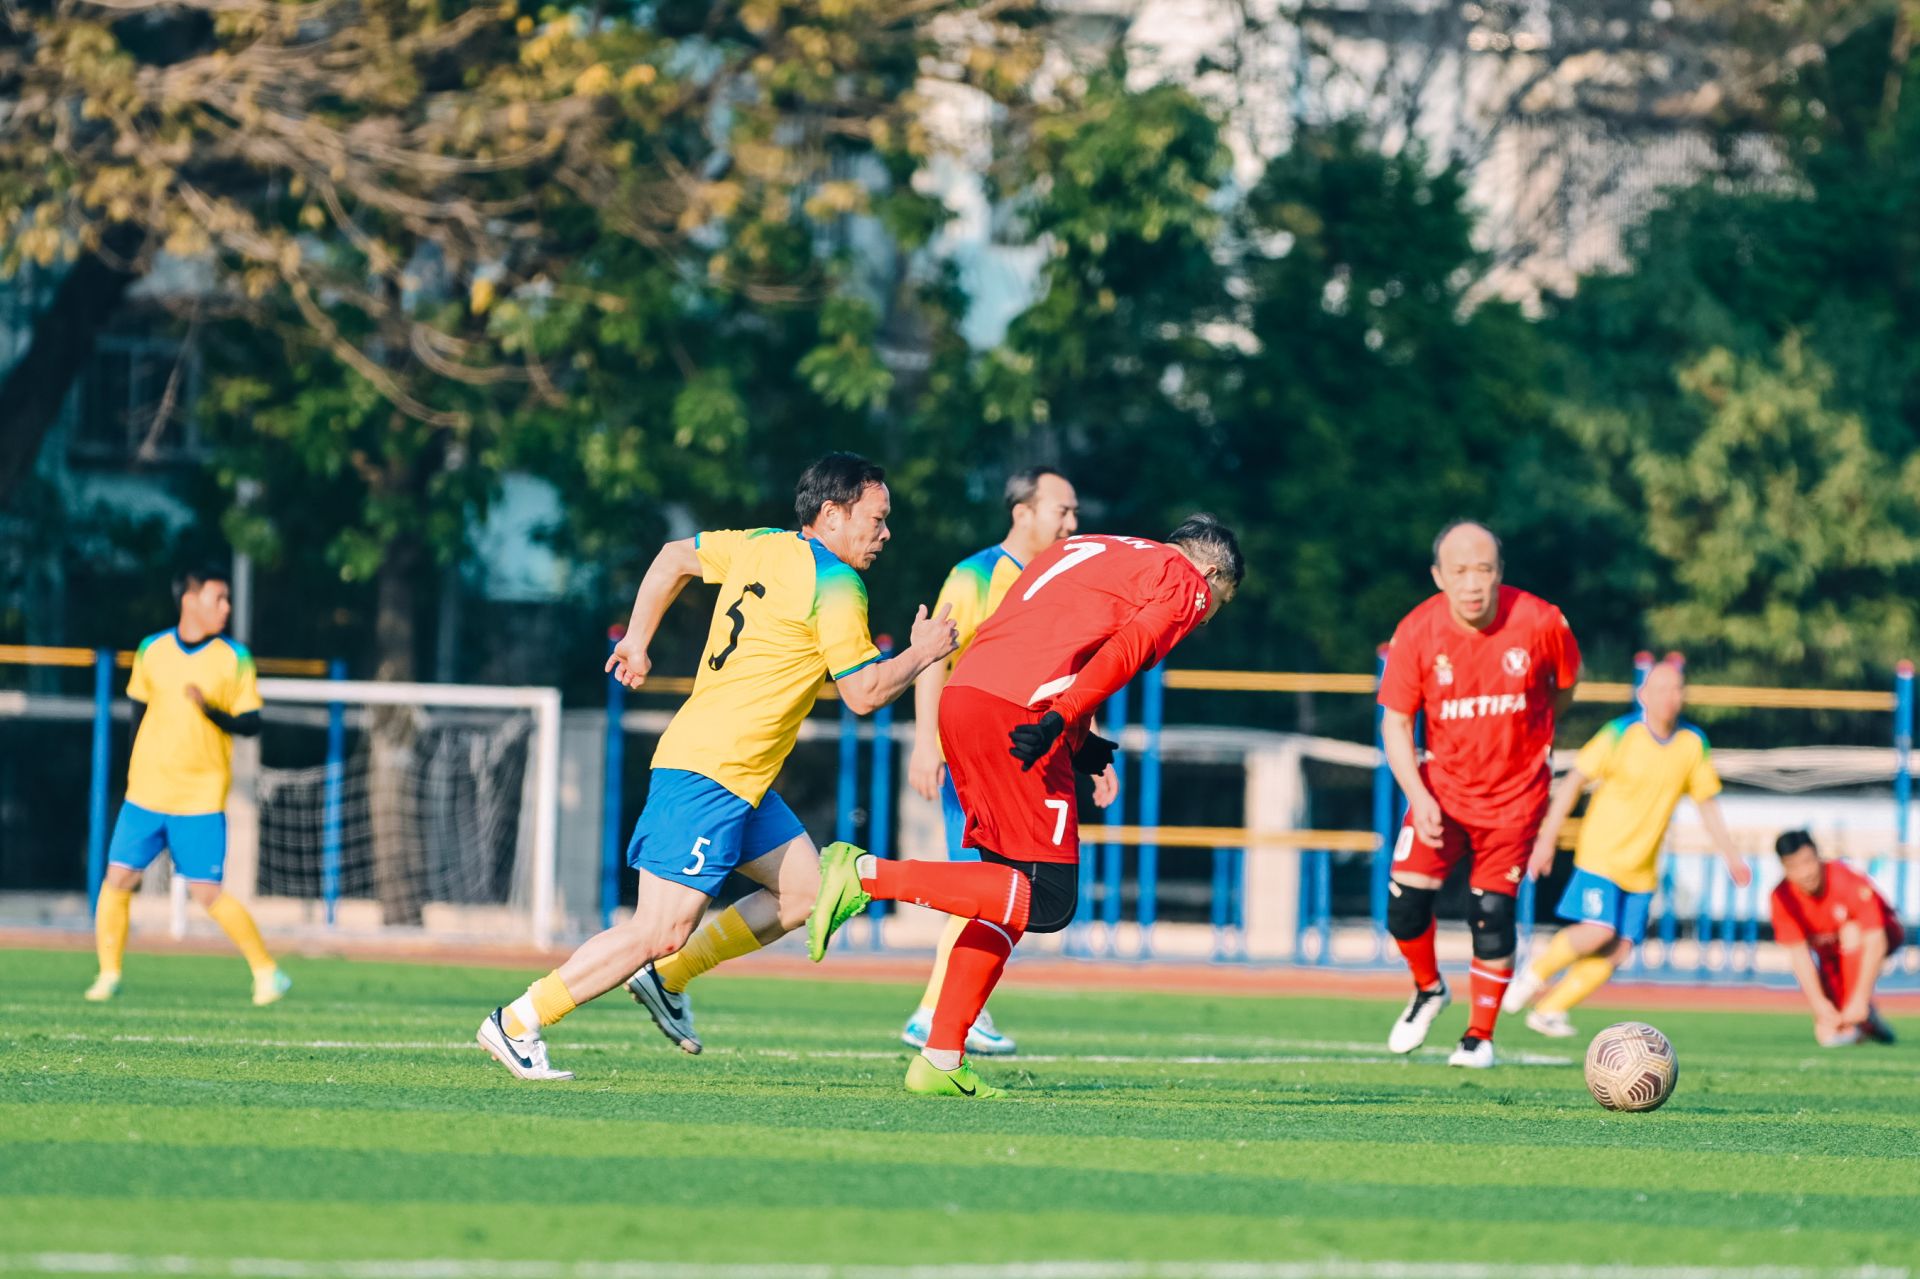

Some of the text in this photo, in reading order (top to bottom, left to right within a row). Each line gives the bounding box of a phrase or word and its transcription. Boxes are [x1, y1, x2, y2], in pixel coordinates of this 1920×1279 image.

[1023, 541, 1106, 601] 7
[708, 581, 766, 671] 5
[1440, 693, 1526, 720] HKTIFA
[1044, 799, 1068, 846] 7
[682, 836, 711, 876] 5
